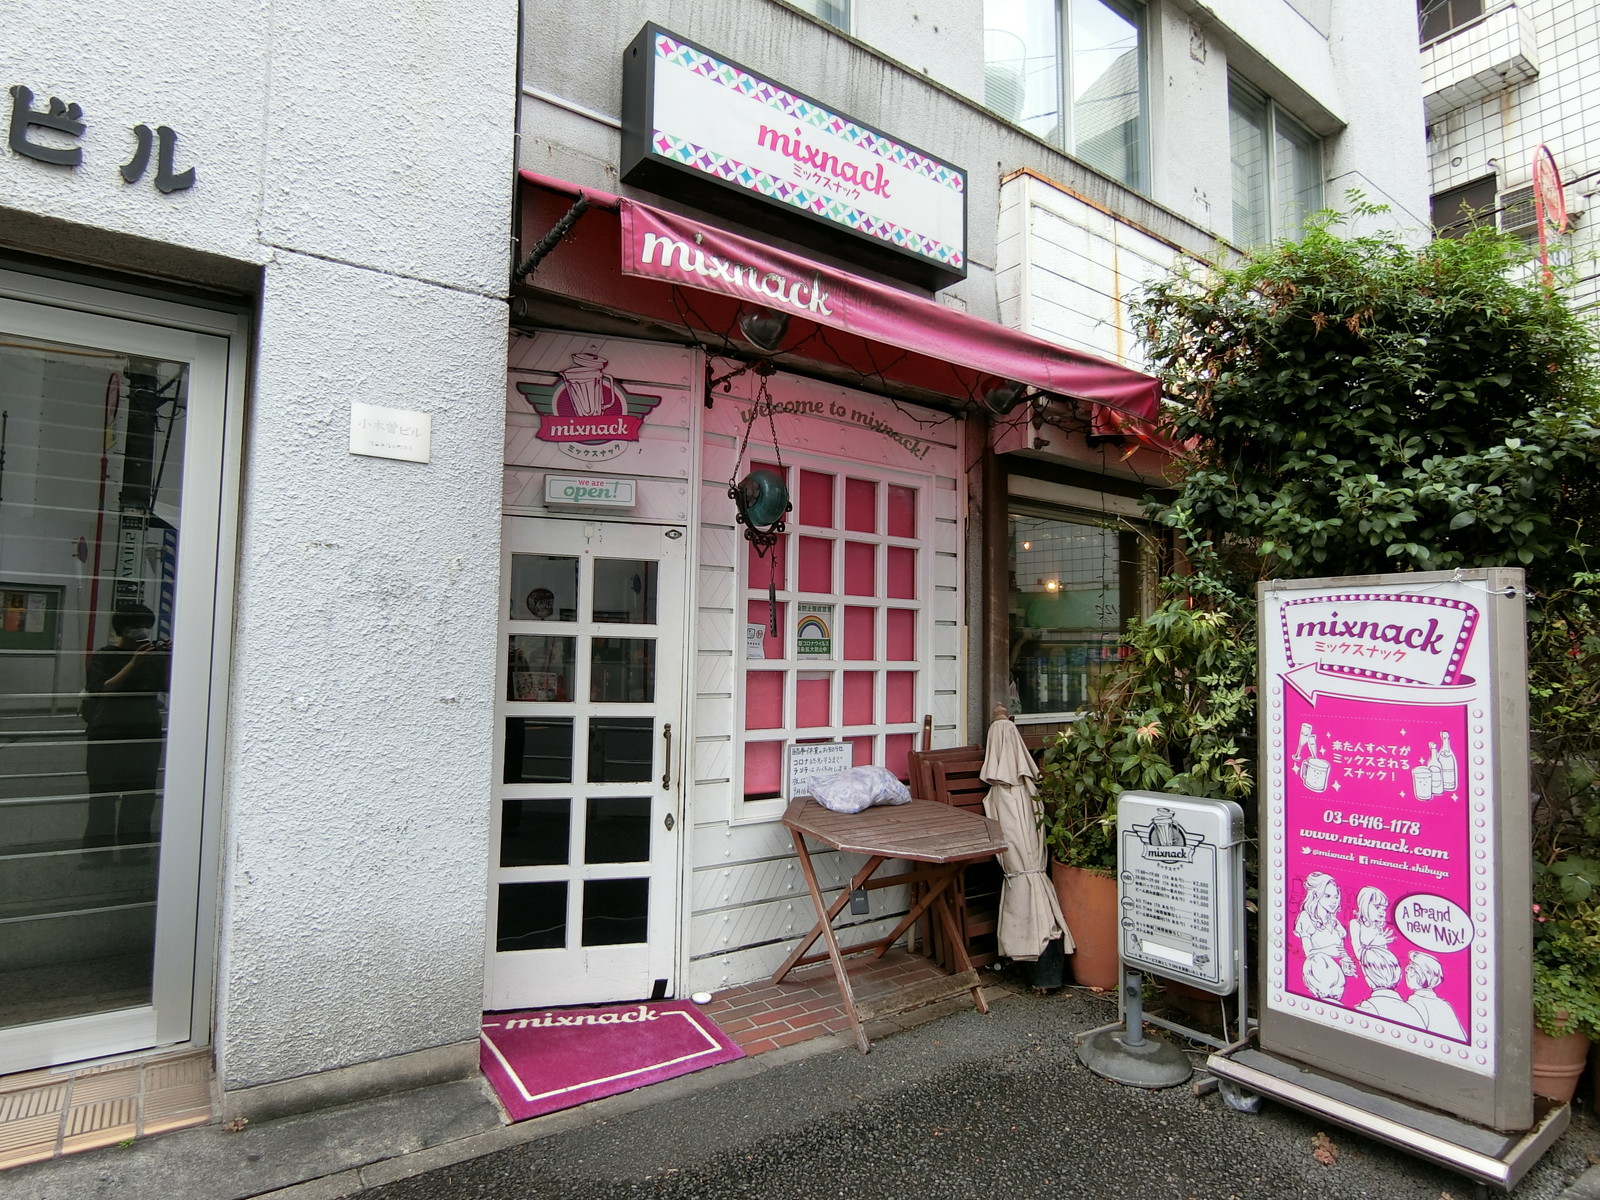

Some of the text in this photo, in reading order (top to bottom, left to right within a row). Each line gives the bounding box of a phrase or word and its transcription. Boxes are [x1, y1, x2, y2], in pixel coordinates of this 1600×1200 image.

[9, 84, 196, 194] ビル
[758, 122, 891, 200] mixnack
[793, 164, 860, 200] ミックスナック
[641, 231, 833, 317] mixnack
[550, 418, 628, 436] mixnack
[741, 394, 931, 461] welcome to mixnack!
[567, 443, 620, 457] ミックスナック
[563, 481, 619, 502] open!
[1295, 610, 1444, 655] mixnack
[1314, 641, 1407, 663] ミックスナック
[1332, 740, 1411, 754] 来た人すべてが
[1332, 754, 1411, 770] ミックスされる
[1323, 809, 1421, 836] 03-6416-1178
[1148, 848, 1187, 859] mixnack
[1299, 828, 1449, 860] www.mixnack.com
[1312, 848, 1450, 879] @mixnack mixnack.shibuya
[1402, 902, 1451, 923] A Brand
[1406, 920, 1465, 946] new Mix!
[504, 1005, 661, 1029] mixnack
